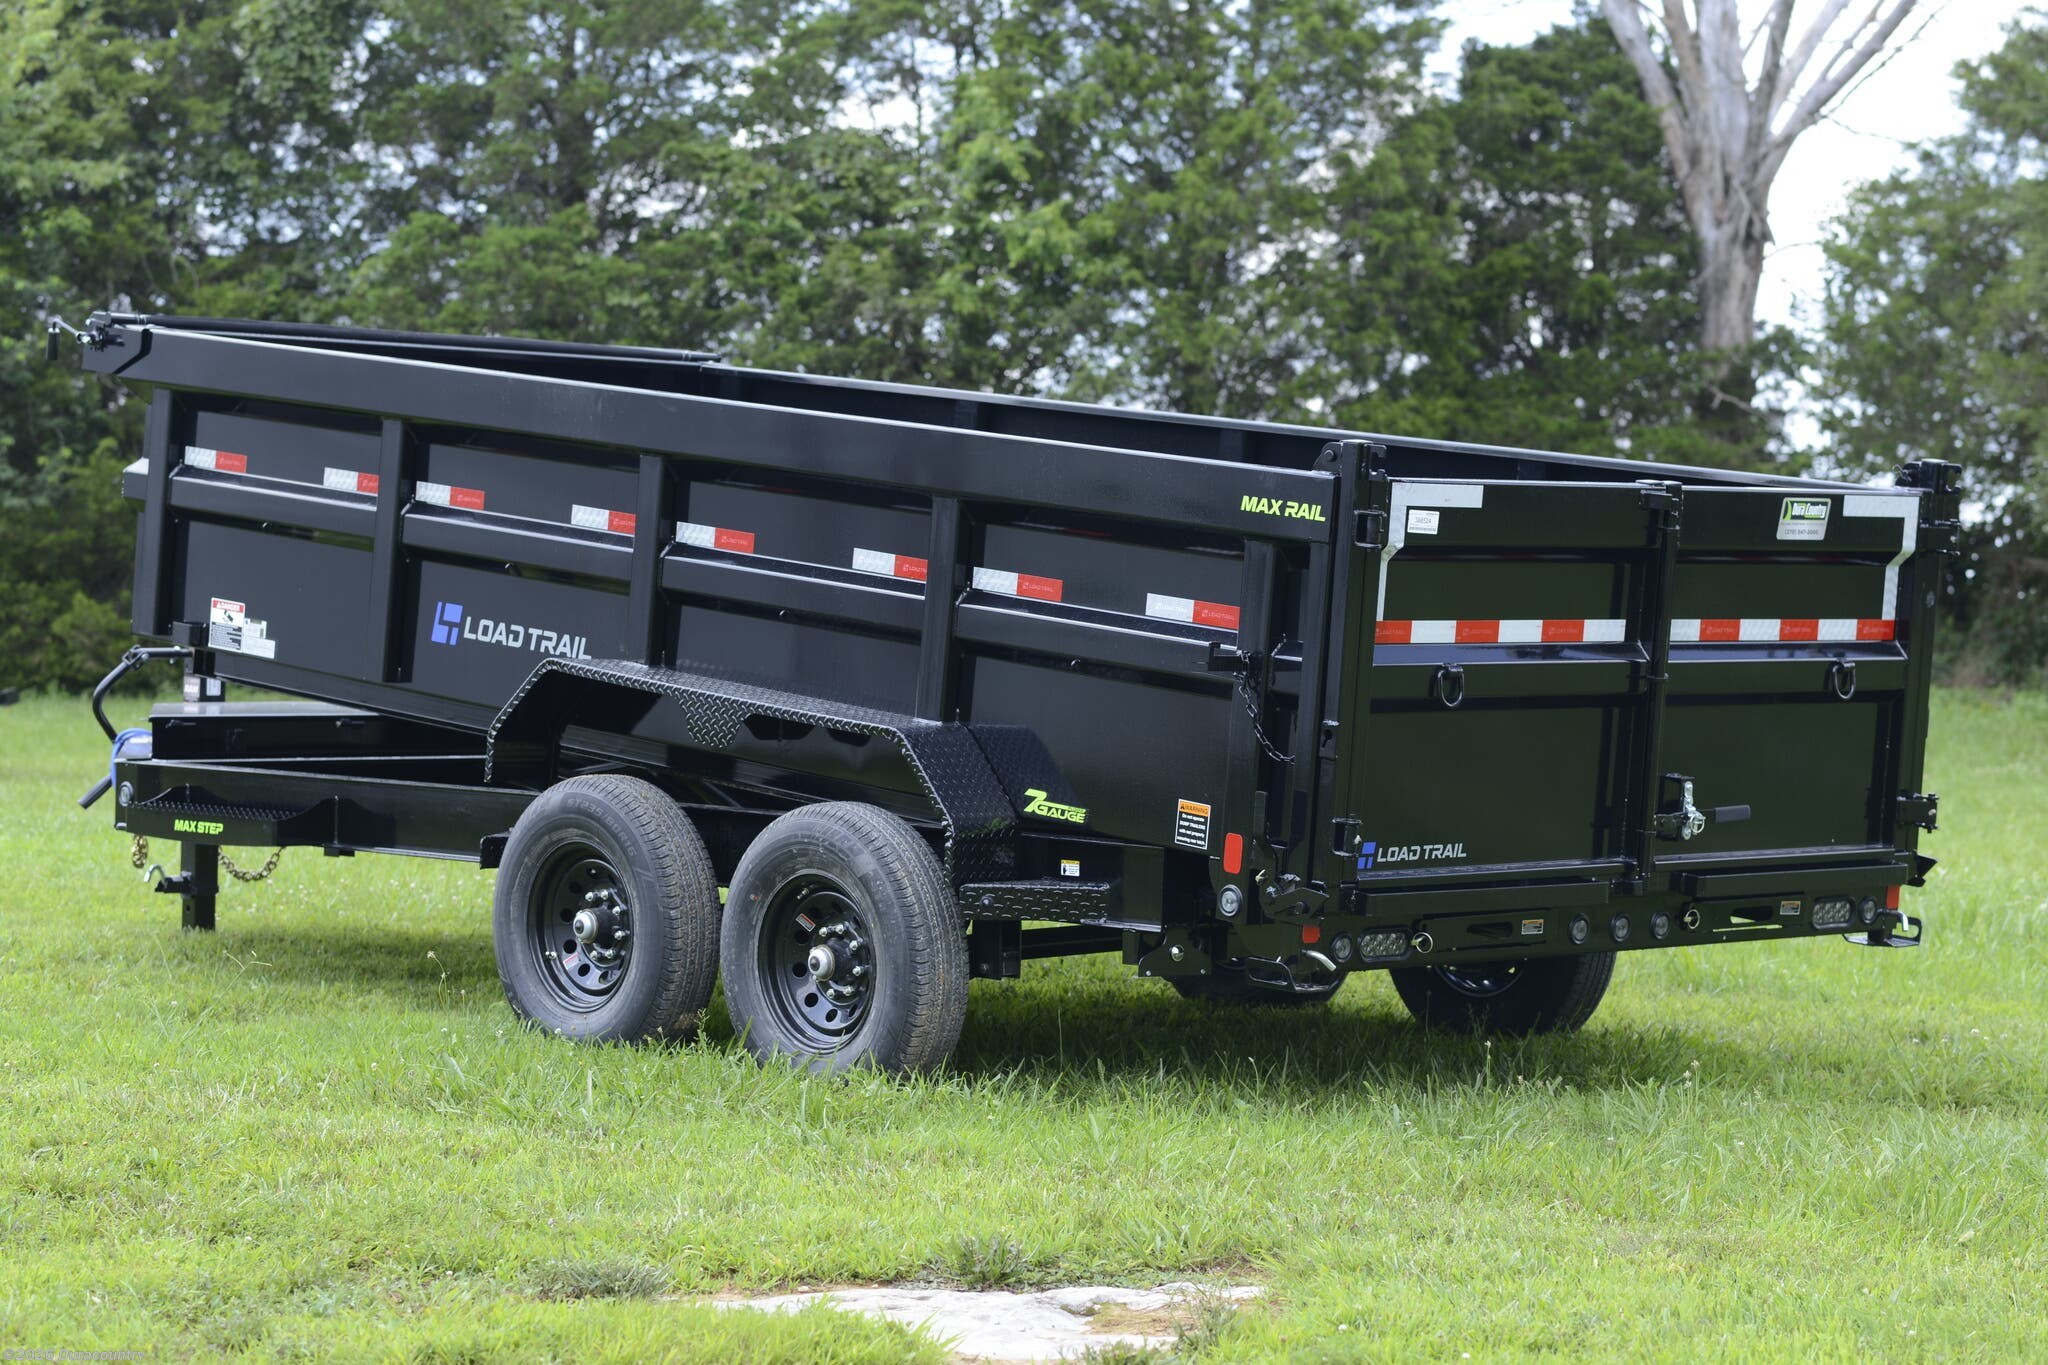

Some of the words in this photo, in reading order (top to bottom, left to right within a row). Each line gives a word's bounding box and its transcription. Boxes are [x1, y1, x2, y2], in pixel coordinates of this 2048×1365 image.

[1240, 495, 1283, 516] MAX
[1284, 501, 1326, 522] RAIL
[463, 616, 525, 648] LOAD
[528, 627, 592, 660] TRAIL
[1024, 788, 1047, 813] 7
[1033, 800, 1086, 823] GAUGE
[174, 819, 197, 833] MAX
[197, 821, 224, 835] STEP
[1377, 845, 1421, 862] LOAD
[1423, 843, 1467, 860] TRAIL
